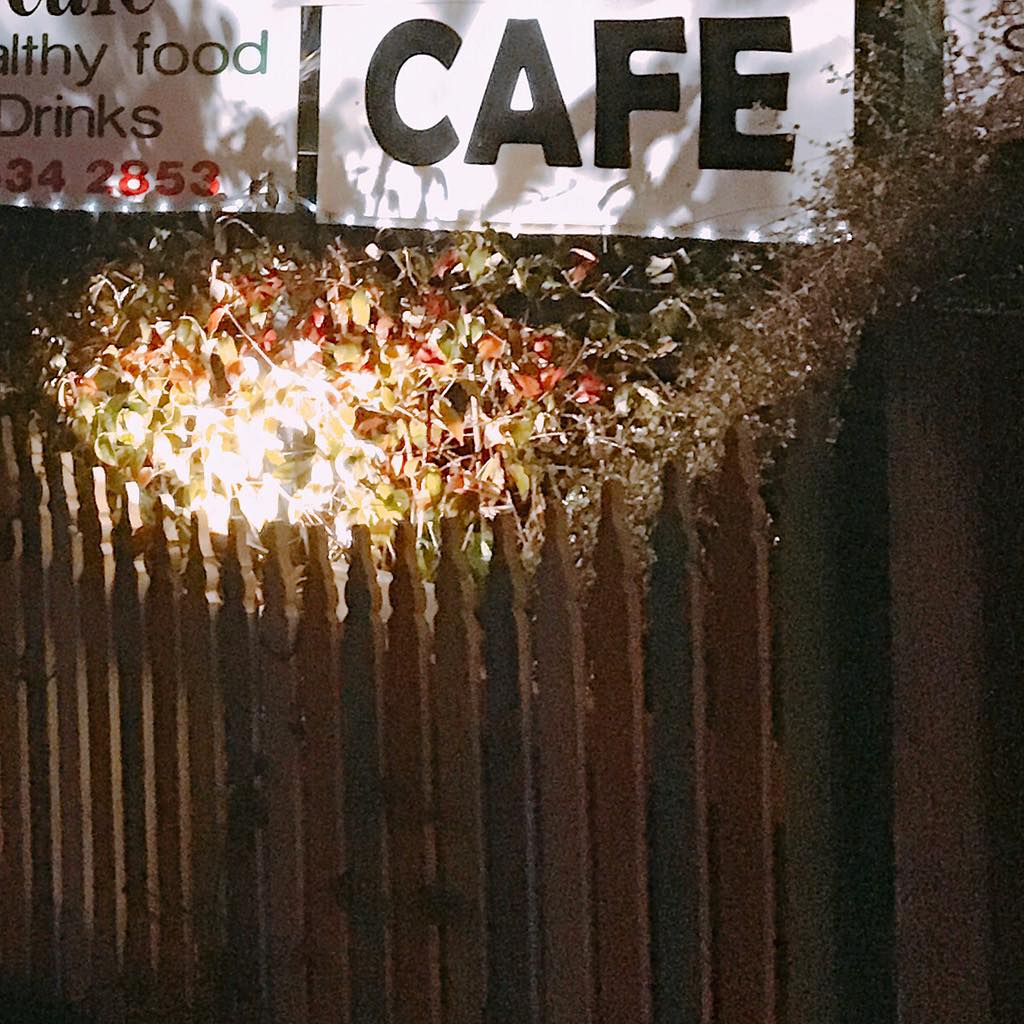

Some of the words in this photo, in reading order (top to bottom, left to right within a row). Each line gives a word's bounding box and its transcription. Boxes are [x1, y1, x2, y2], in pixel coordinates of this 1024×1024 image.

[133, 29, 269, 76] food
[364, 16, 796, 170] CAFE
[85, 159, 222, 196] 2853
